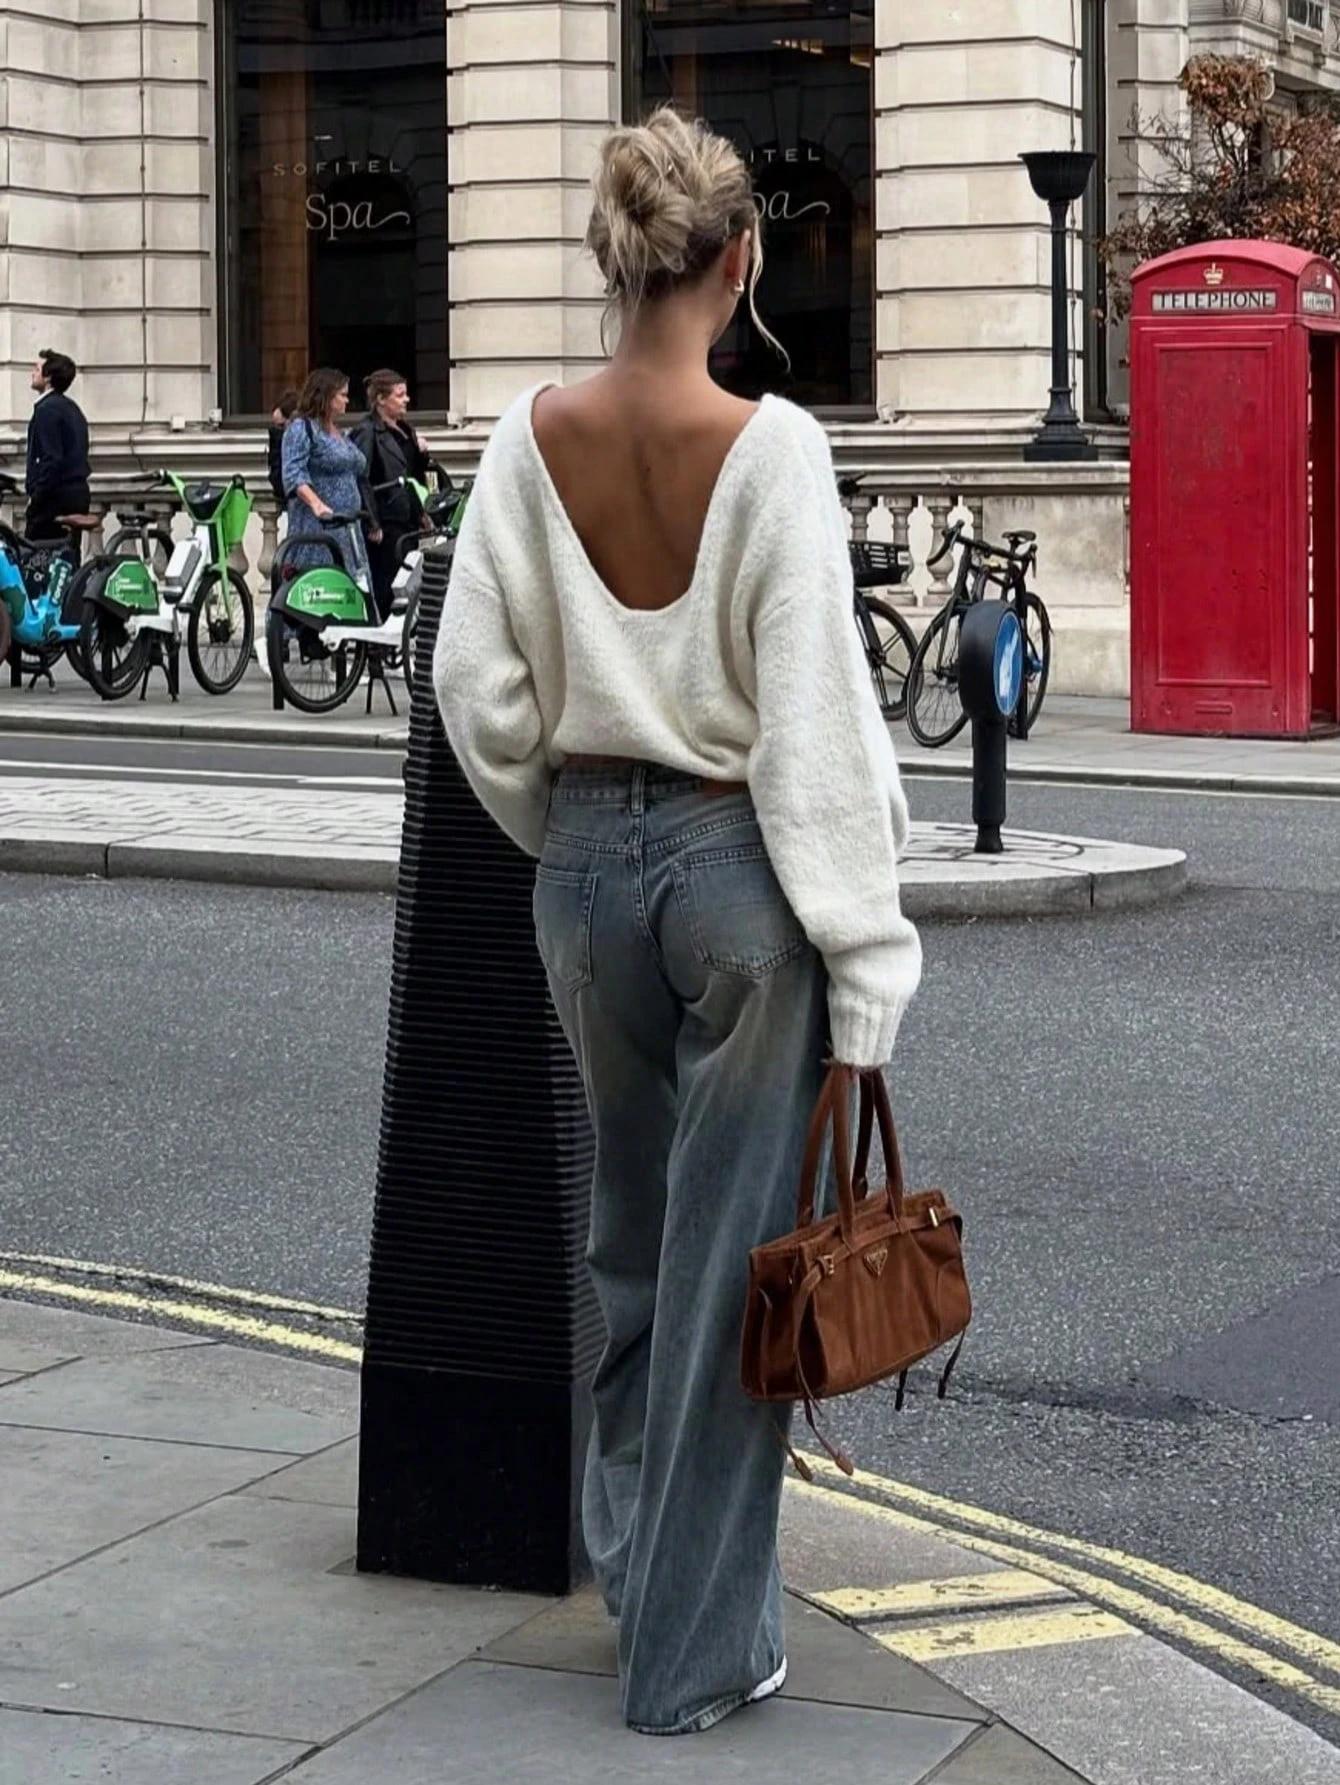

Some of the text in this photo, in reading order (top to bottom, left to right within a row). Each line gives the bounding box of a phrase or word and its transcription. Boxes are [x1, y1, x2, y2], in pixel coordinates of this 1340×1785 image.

[749, 148, 821, 163] ITEL
[273, 160, 401, 176] SOFITEL
[305, 193, 410, 241] Spa
[1157, 291, 1273, 308] TELEPHONE
